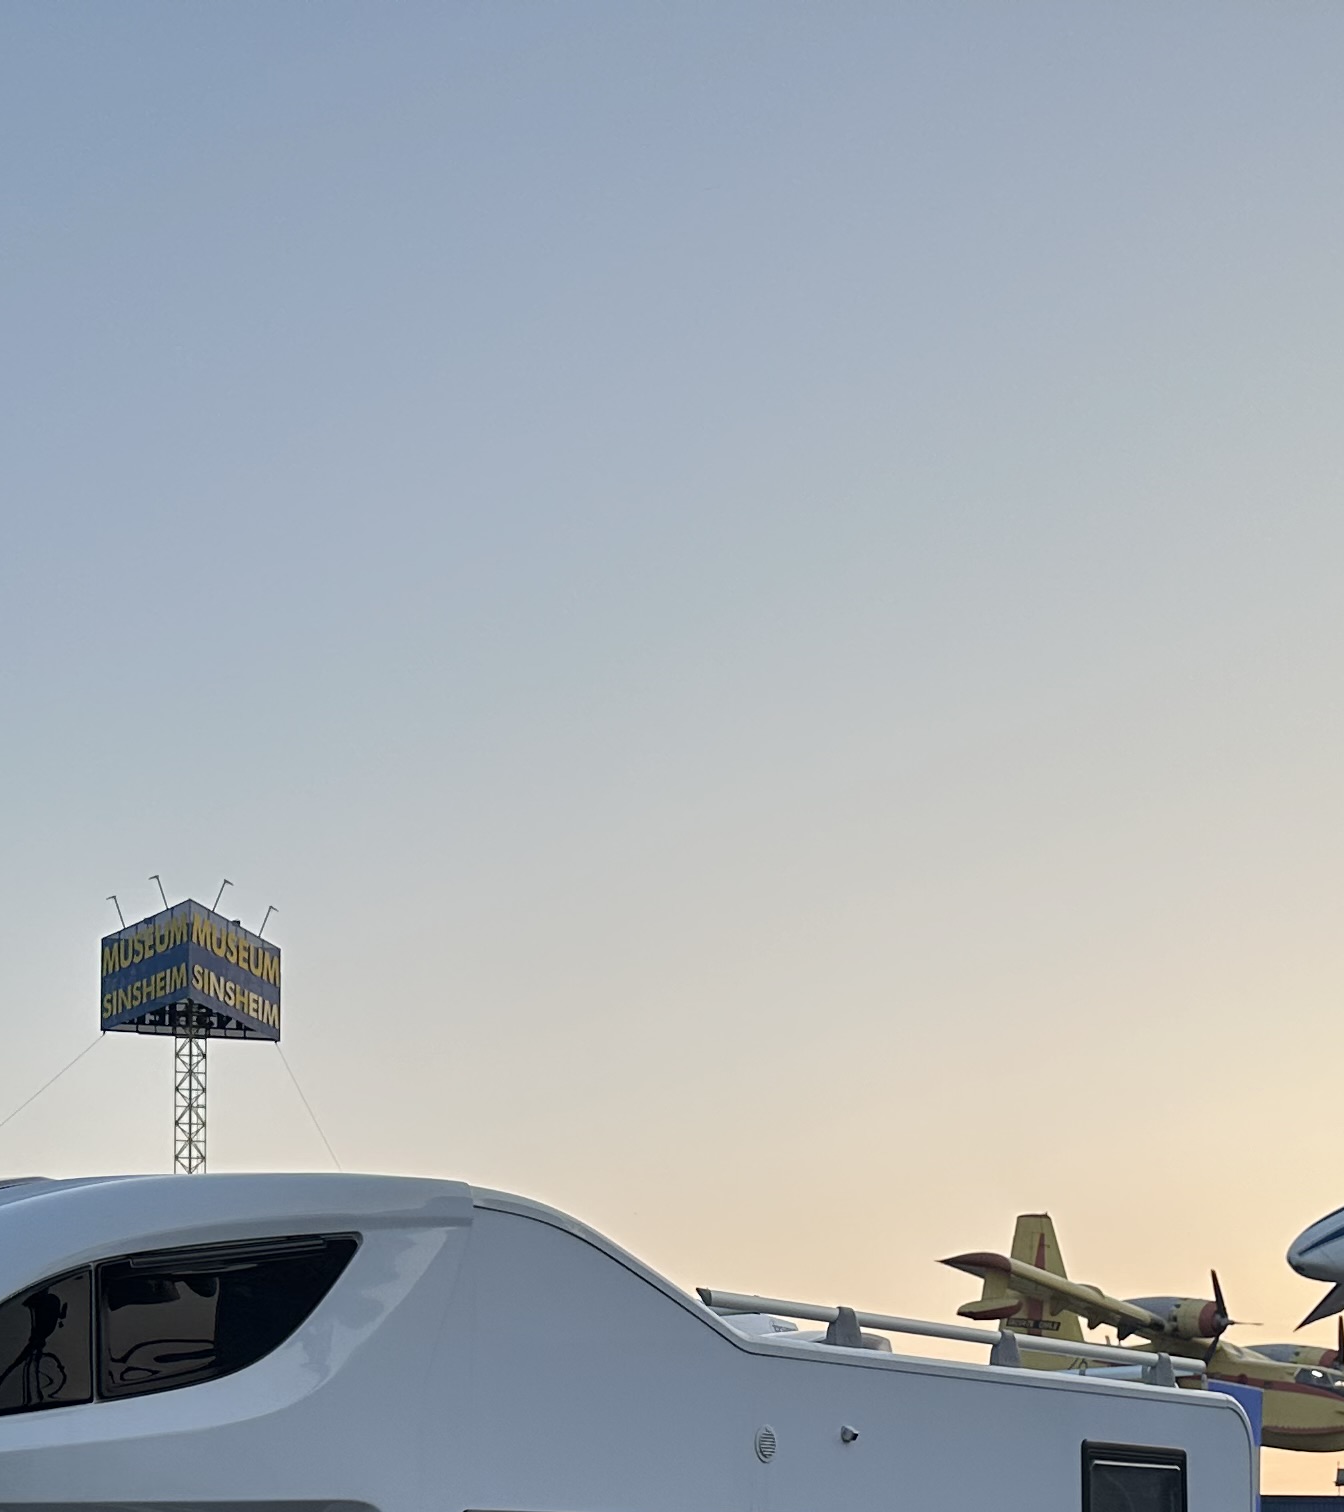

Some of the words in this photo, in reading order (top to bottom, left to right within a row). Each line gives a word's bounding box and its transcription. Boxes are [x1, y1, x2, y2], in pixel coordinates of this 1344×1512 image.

[103, 912, 189, 977] MUSEUM
[191, 912, 280, 987] MUSEUM
[102, 962, 188, 1018] SINSHEIM
[191, 964, 280, 1029] SINSHEIM
